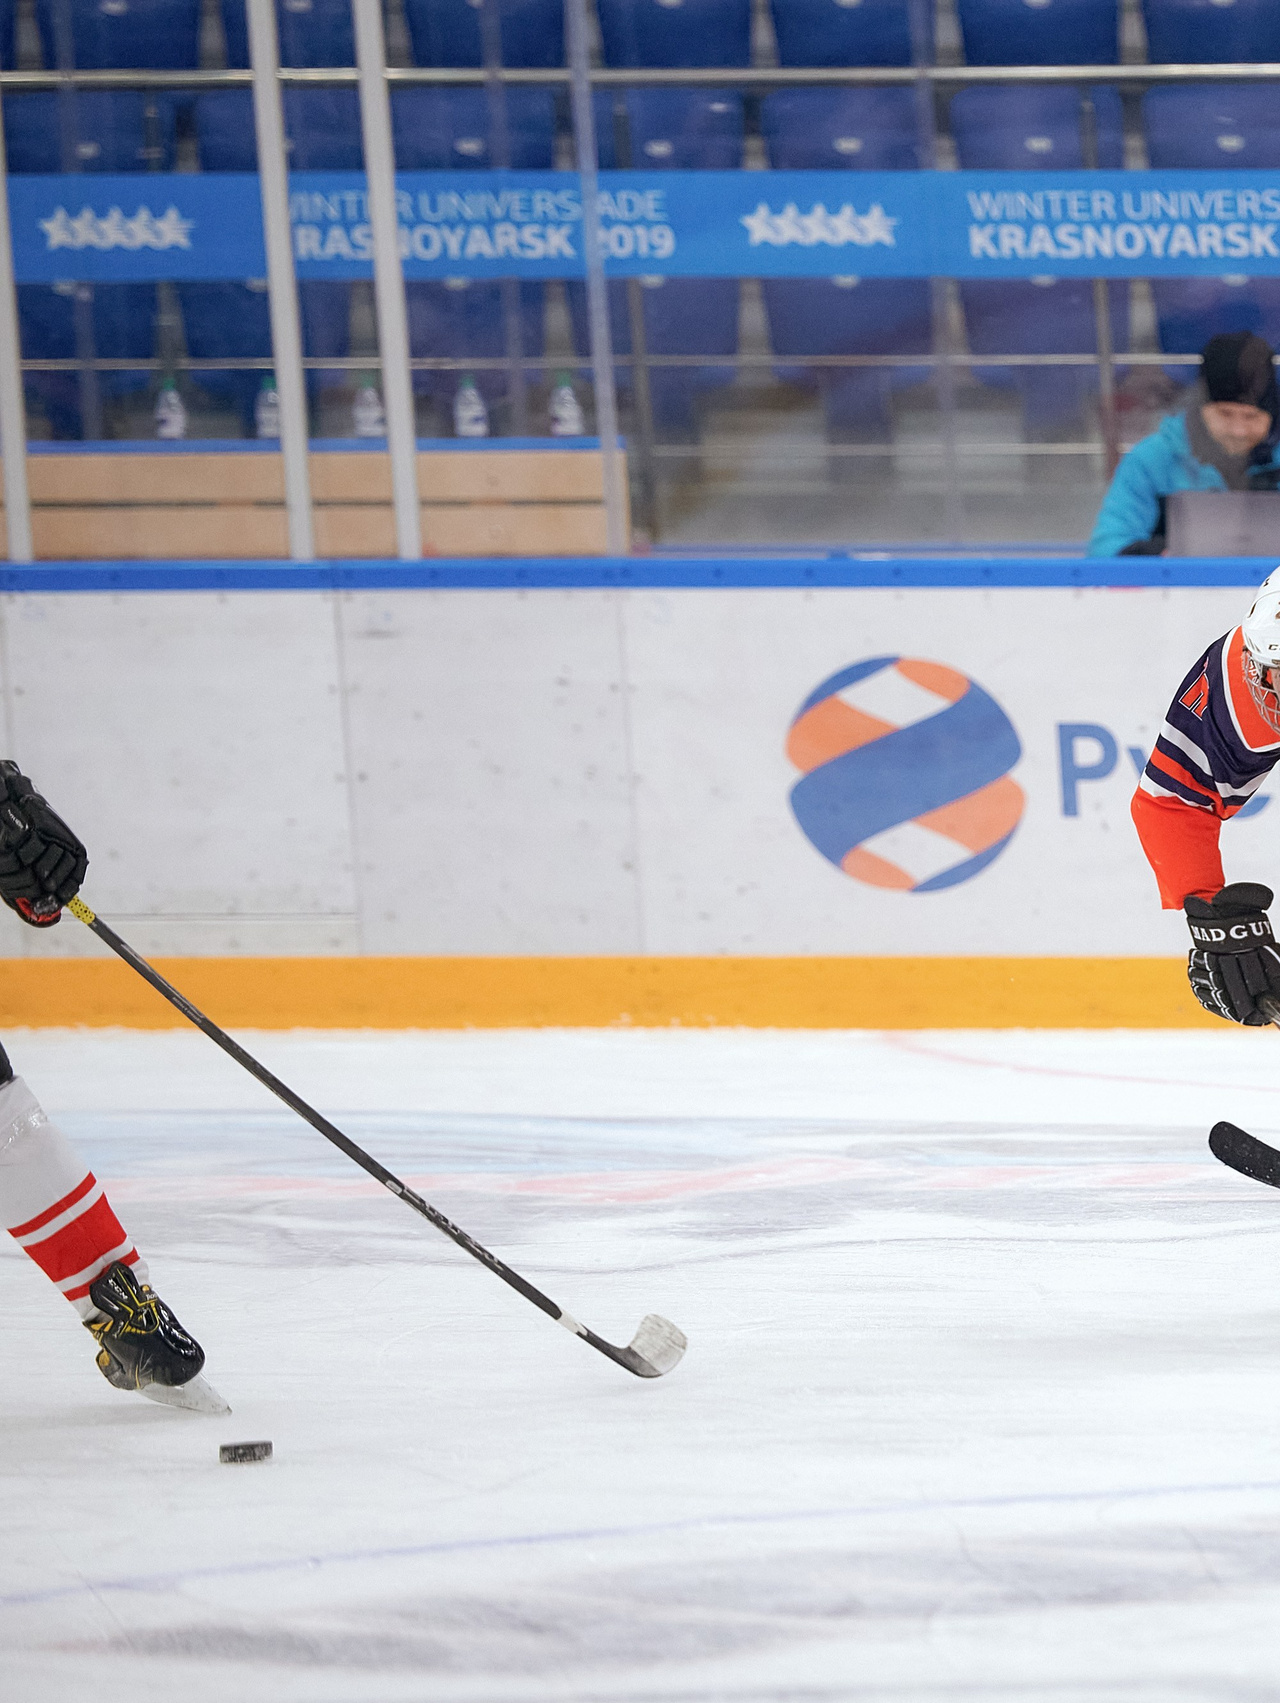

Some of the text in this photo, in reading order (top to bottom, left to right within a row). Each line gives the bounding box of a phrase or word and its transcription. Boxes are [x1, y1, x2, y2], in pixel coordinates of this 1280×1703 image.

[290, 188, 669, 221] INTR UNIVERSADE
[967, 189, 1117, 221] WINTER
[295, 224, 578, 260] RASOYARSK
[1229, 920, 1273, 940] GUY
